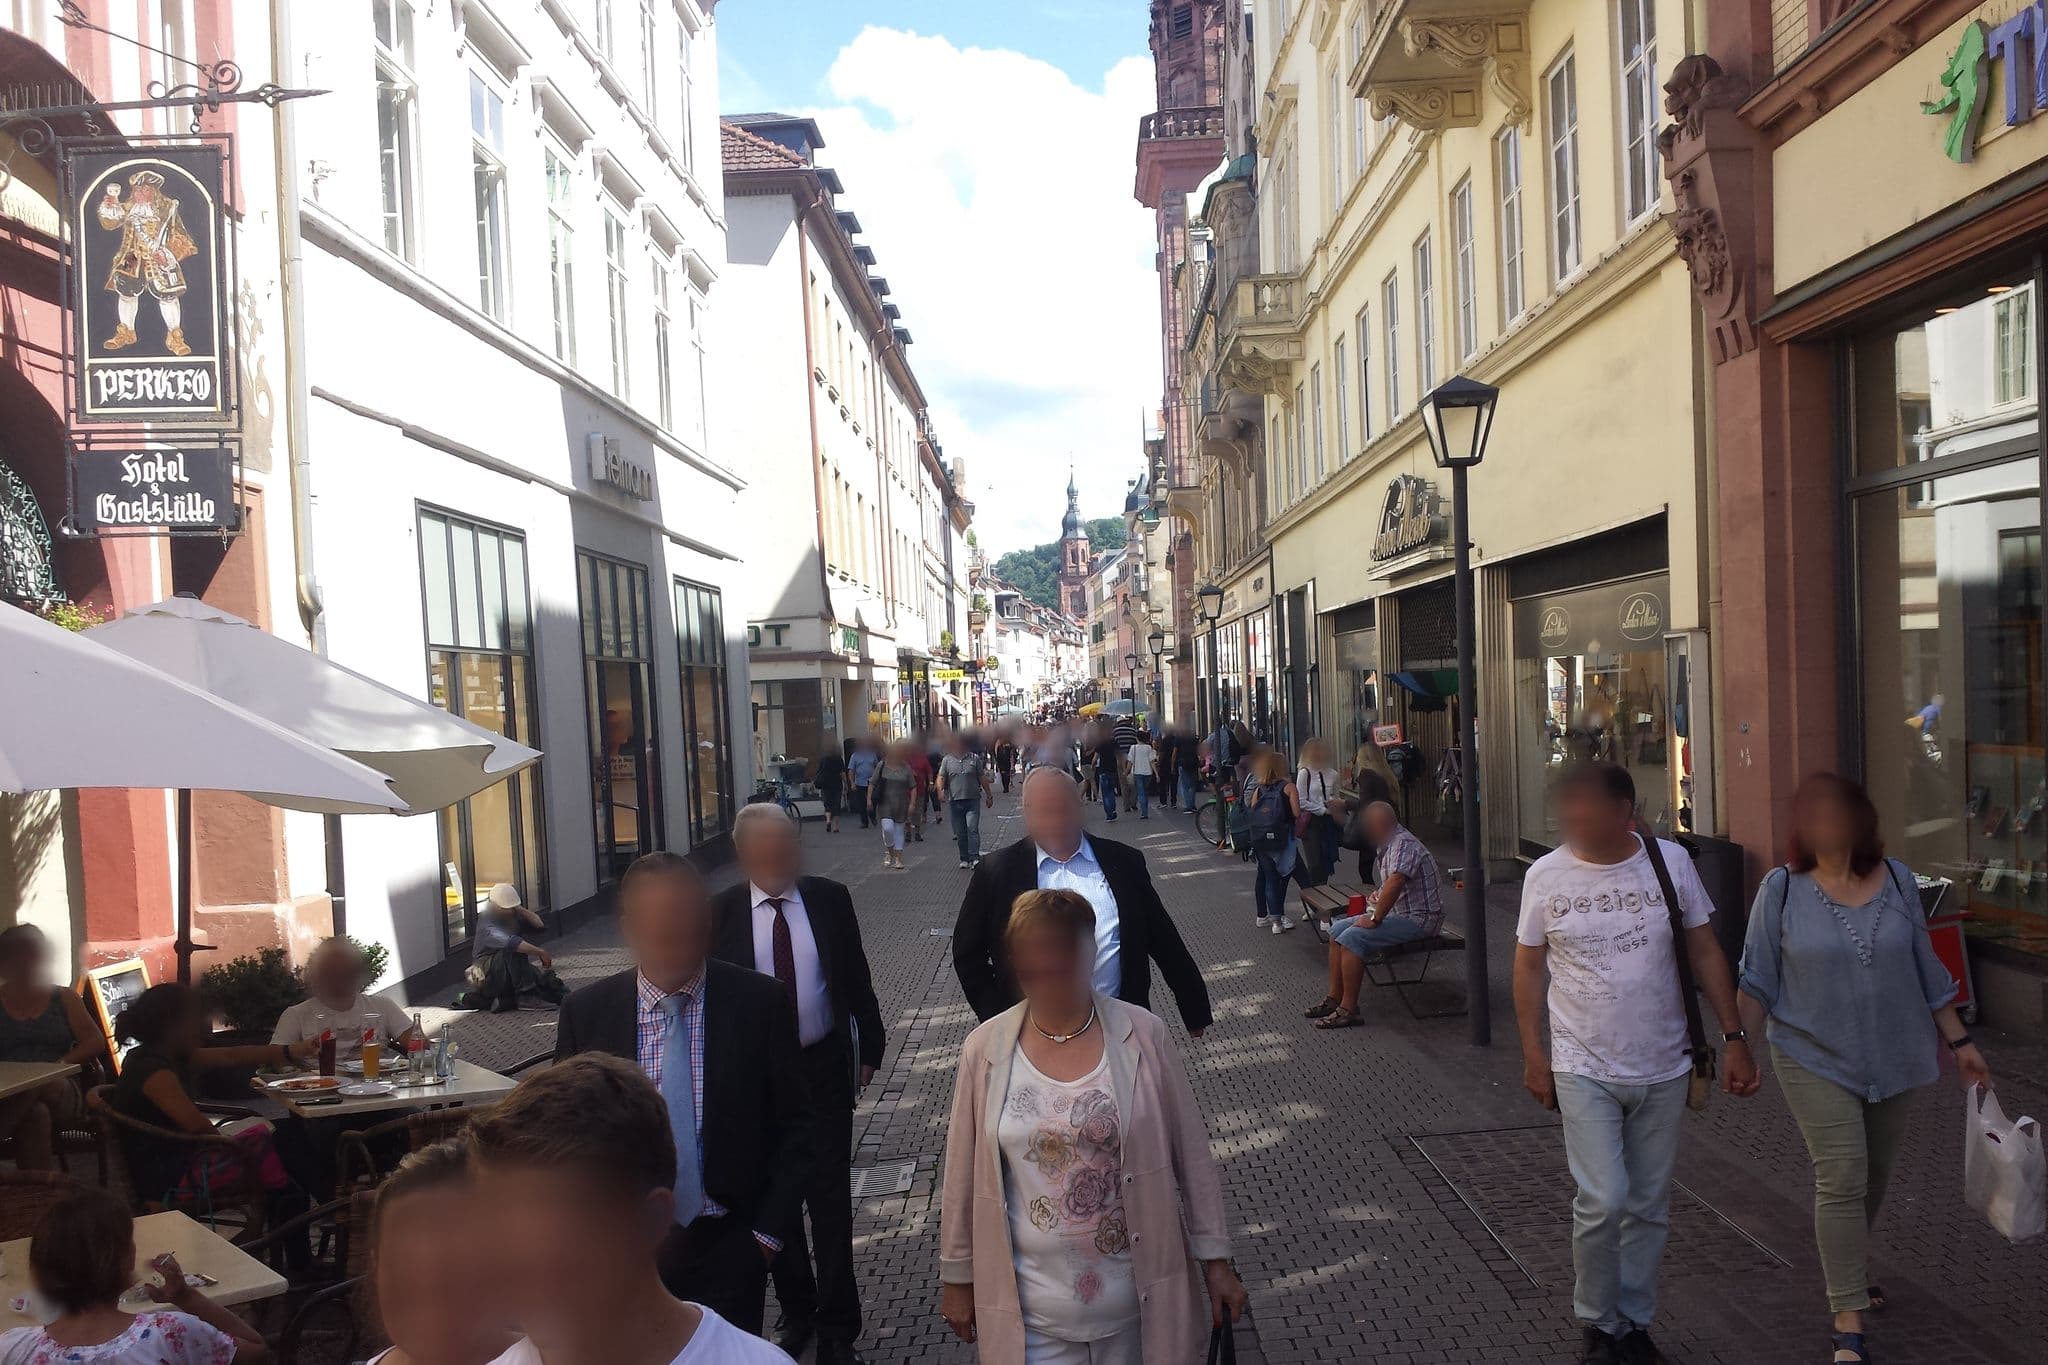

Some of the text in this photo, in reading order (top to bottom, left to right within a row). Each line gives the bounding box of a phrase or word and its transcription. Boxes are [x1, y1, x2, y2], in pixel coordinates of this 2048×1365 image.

[93, 367, 211, 404] PERKEO
[121, 452, 190, 487] Hotel
[150, 482, 161, 496] &
[96, 492, 215, 524] Gaststätte
[937, 671, 962, 679] CALIDA
[1615, 935, 1649, 954] less
